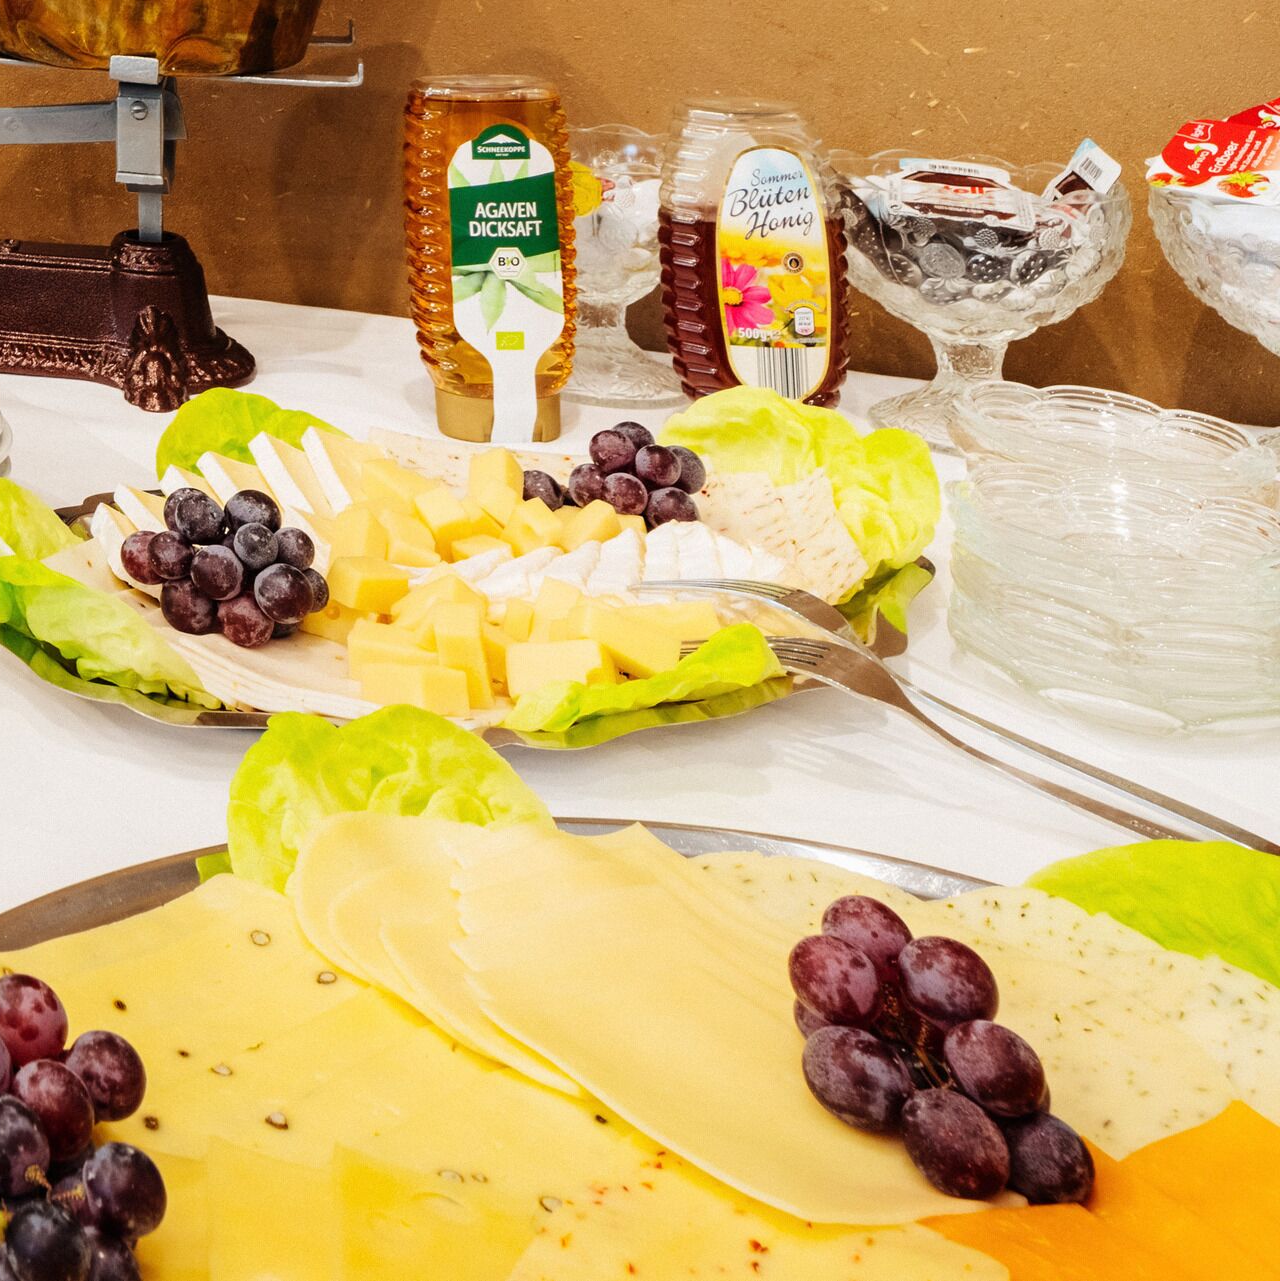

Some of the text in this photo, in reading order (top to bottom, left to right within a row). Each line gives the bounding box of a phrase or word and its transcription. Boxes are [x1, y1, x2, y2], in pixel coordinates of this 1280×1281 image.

[477, 145, 526, 153] SCHNEEKOPPE
[1208, 140, 1239, 173] Erdbeer
[474, 201, 537, 218] AGAVEN
[727, 185, 810, 217] Blüten
[468, 220, 543, 237] DICKSAFT
[744, 206, 814, 240] Honig
